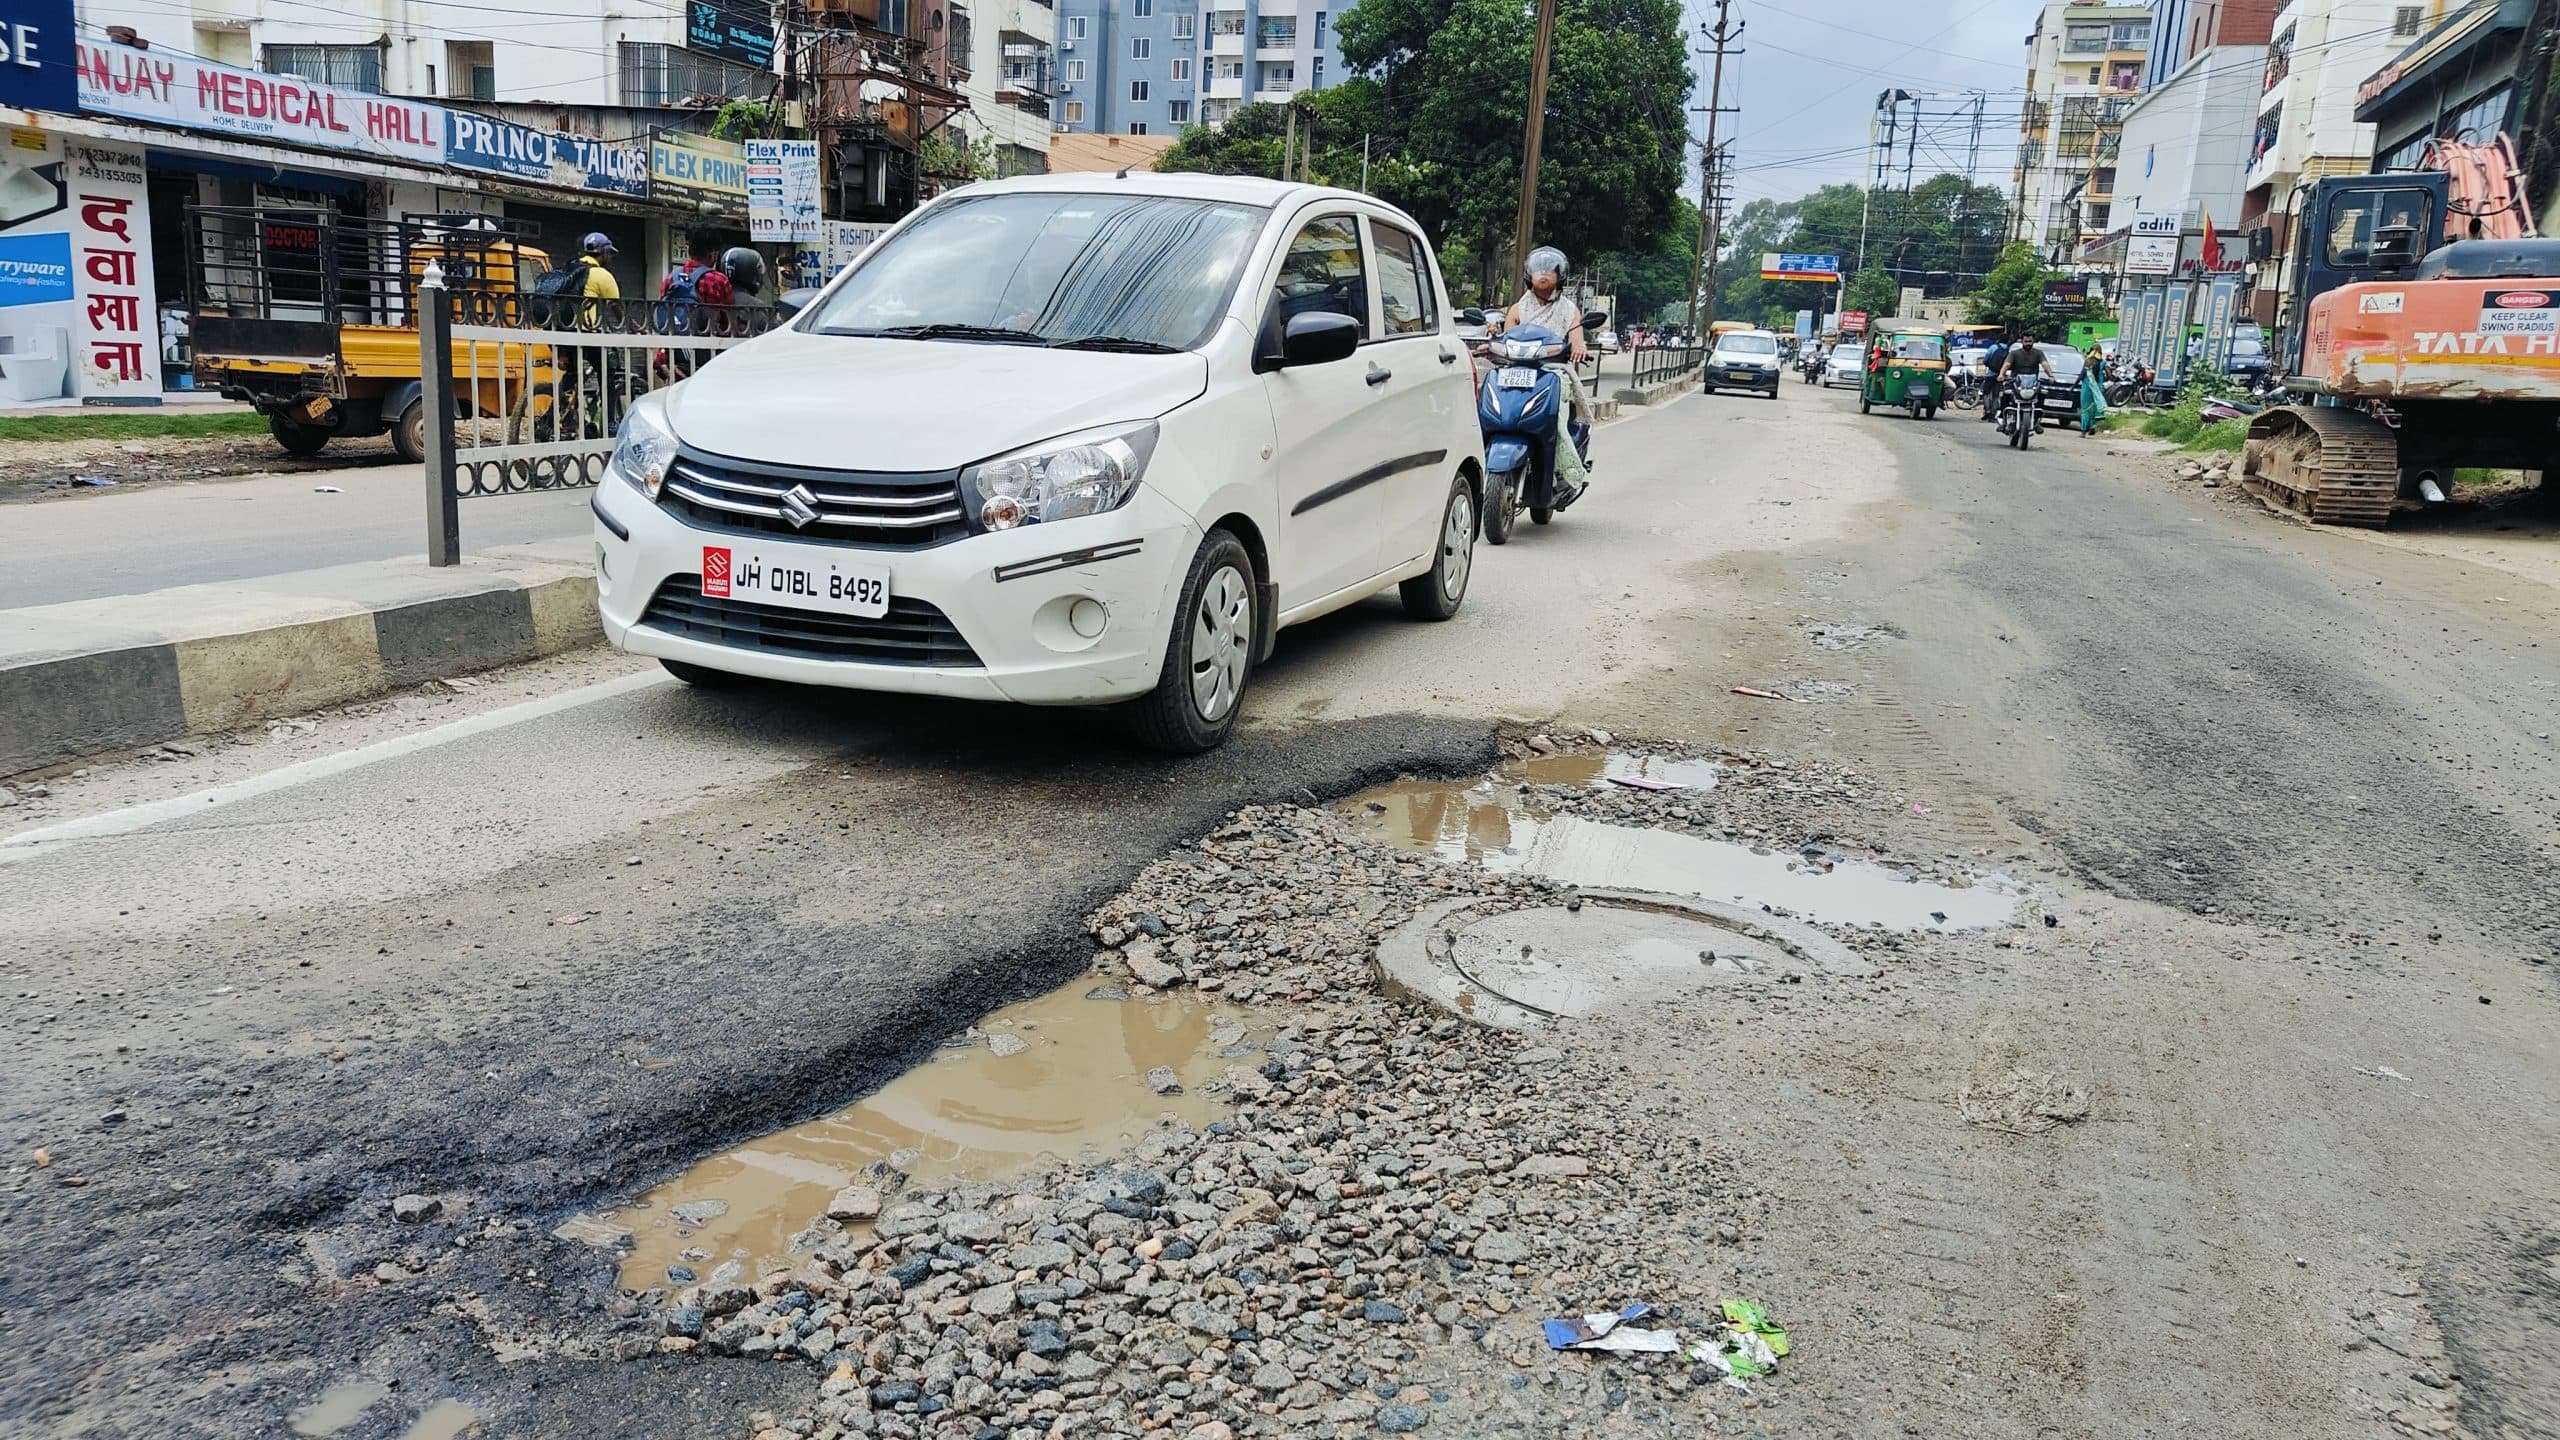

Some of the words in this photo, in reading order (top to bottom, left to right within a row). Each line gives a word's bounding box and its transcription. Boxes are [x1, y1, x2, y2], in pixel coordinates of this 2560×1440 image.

[197, 68, 349, 133] MEDICAL
[366, 101, 437, 147] HALL
[212, 115, 238, 129] HOME
[241, 119, 274, 134] DELIVERY
[453, 111, 560, 165] PRINCE
[573, 141, 647, 180] TAILORS
[747, 142, 777, 156] Flex
[782, 143, 816, 157] Print
[654, 147, 698, 181] FLEX
[702, 157, 748, 189] PRINT
[751, 218, 774, 231] HD
[780, 218, 816, 231] Print
[2138, 217, 2175, 231] aditi
[265, 226, 316, 249] DOCTOR
[2044, 293, 2063, 304] Stay
[2064, 294, 2085, 303] Villa
[2501, 296, 2543, 305] DANGER
[2491, 312, 2515, 322] KEEP
[2517, 312, 2548, 322] CLEAR
[2481, 322, 2515, 332] SWING
[2516, 322, 2555, 332] RADIUS
[2413, 332, 2508, 354] TATA
[2525, 334, 2560, 354] H
[736, 563, 761, 589] JH
[771, 567, 818, 596] 01BL
[829, 574, 883, 605] 8492
